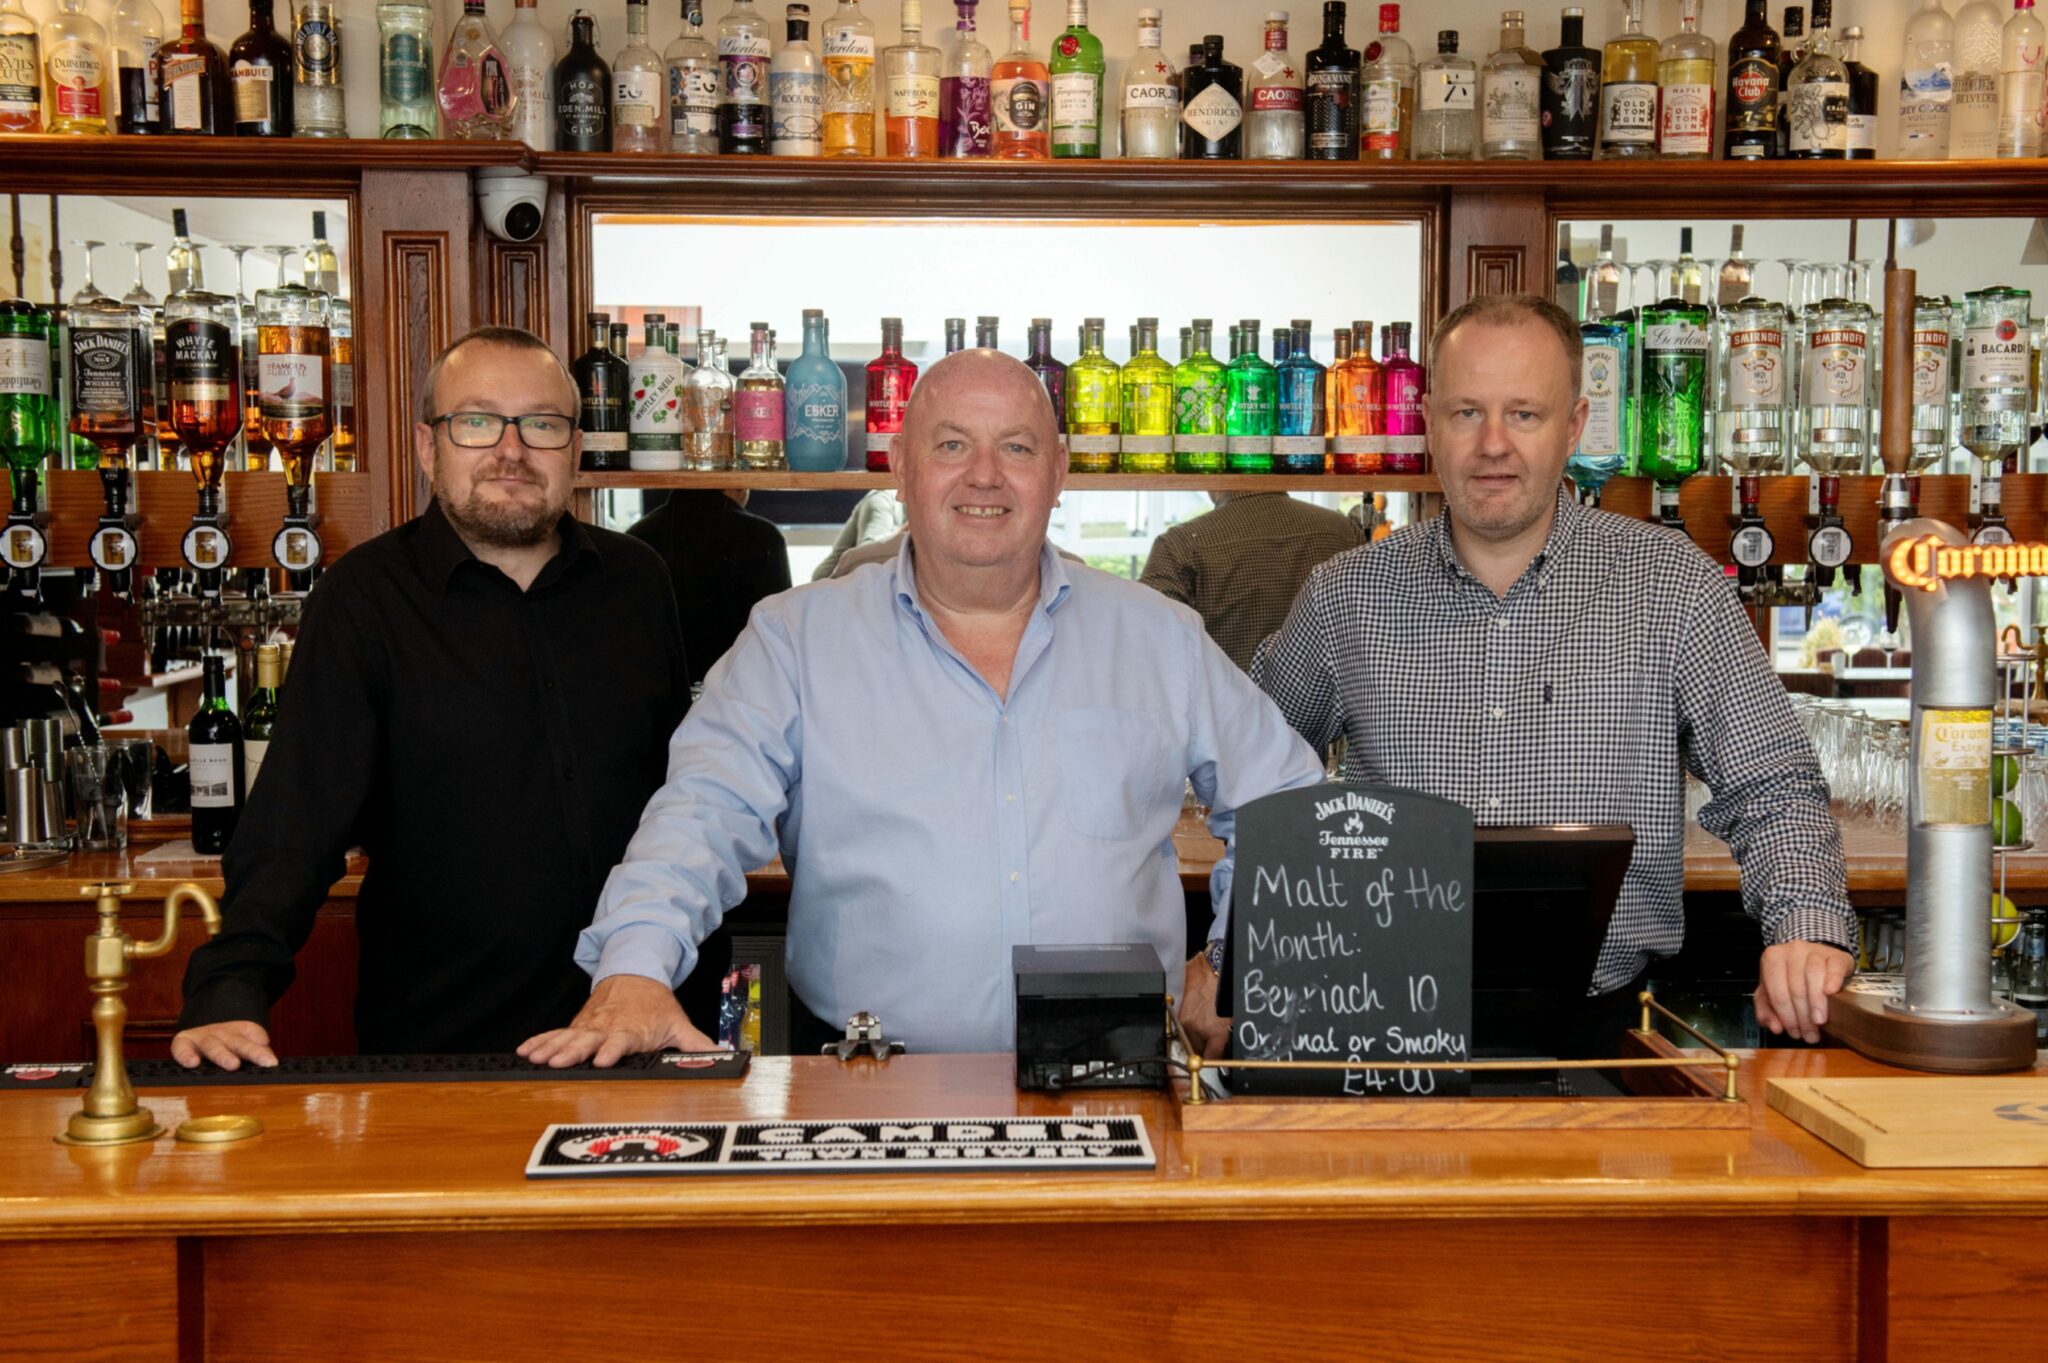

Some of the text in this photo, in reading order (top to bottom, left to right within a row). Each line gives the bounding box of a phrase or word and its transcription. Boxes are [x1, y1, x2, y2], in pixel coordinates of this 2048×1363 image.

[570, 81, 594, 90] HOP
[1732, 76, 1770, 88] Havana
[1738, 86, 1761, 97] Club
[1956, 94, 1998, 104] BELVEDER
[1015, 102, 1036, 111] GIN
[571, 126, 593, 135] GIN
[175, 335, 216, 350] WHYTE
[1652, 327, 1705, 346] Gordon's
[1734, 331, 1780, 345] SMIRNOFF
[1815, 331, 1864, 345] SMIRNOFF
[1914, 332, 1947, 345] IRNOFF
[73, 338, 97, 355] JACK
[175, 350, 218, 361] MACKAY
[635, 390, 659, 420] WHITLEY
[657, 373, 676, 394] NEILL
[804, 404, 839, 418] ESKER
[1314, 796, 1347, 821] JACK
[1319, 830, 1389, 846] Tennessee
[1329, 847, 1378, 859] FIRE
[1252, 864, 1466, 928] Malt of the
[1247, 918, 1362, 962] Month:
[1408, 974, 1439, 1013] 10
[1348, 1034, 1376, 1052] or
[1386, 1025, 1468, 1072] Smoky
